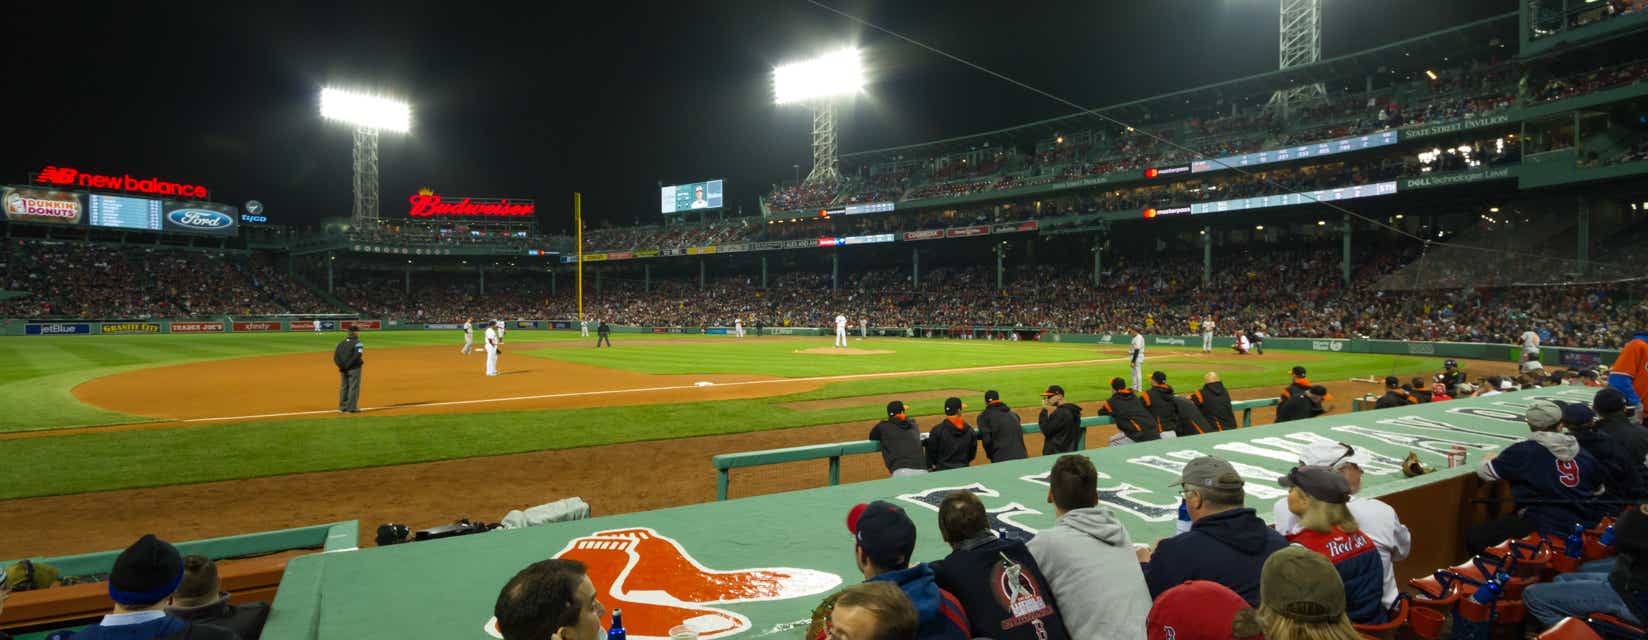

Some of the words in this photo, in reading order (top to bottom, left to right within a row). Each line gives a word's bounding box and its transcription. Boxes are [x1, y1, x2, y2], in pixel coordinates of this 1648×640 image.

[1406, 128, 1429, 137] STATE
[1431, 122, 1462, 134] STREET
[1464, 115, 1508, 130] PAVILION
[79, 173, 123, 190] new
[124, 174, 207, 199] balance
[28, 207, 74, 217] DONUTS
[409, 195, 536, 217] Budweiser
[181, 210, 221, 226] Ford
[241, 213, 267, 223] tyco
[40, 323, 77, 334] jetBlue
[103, 323, 138, 332] GRANITE
[140, 323, 158, 332] CITY
[1555, 457, 1580, 487] 9
[1326, 536, 1353, 558] Red
